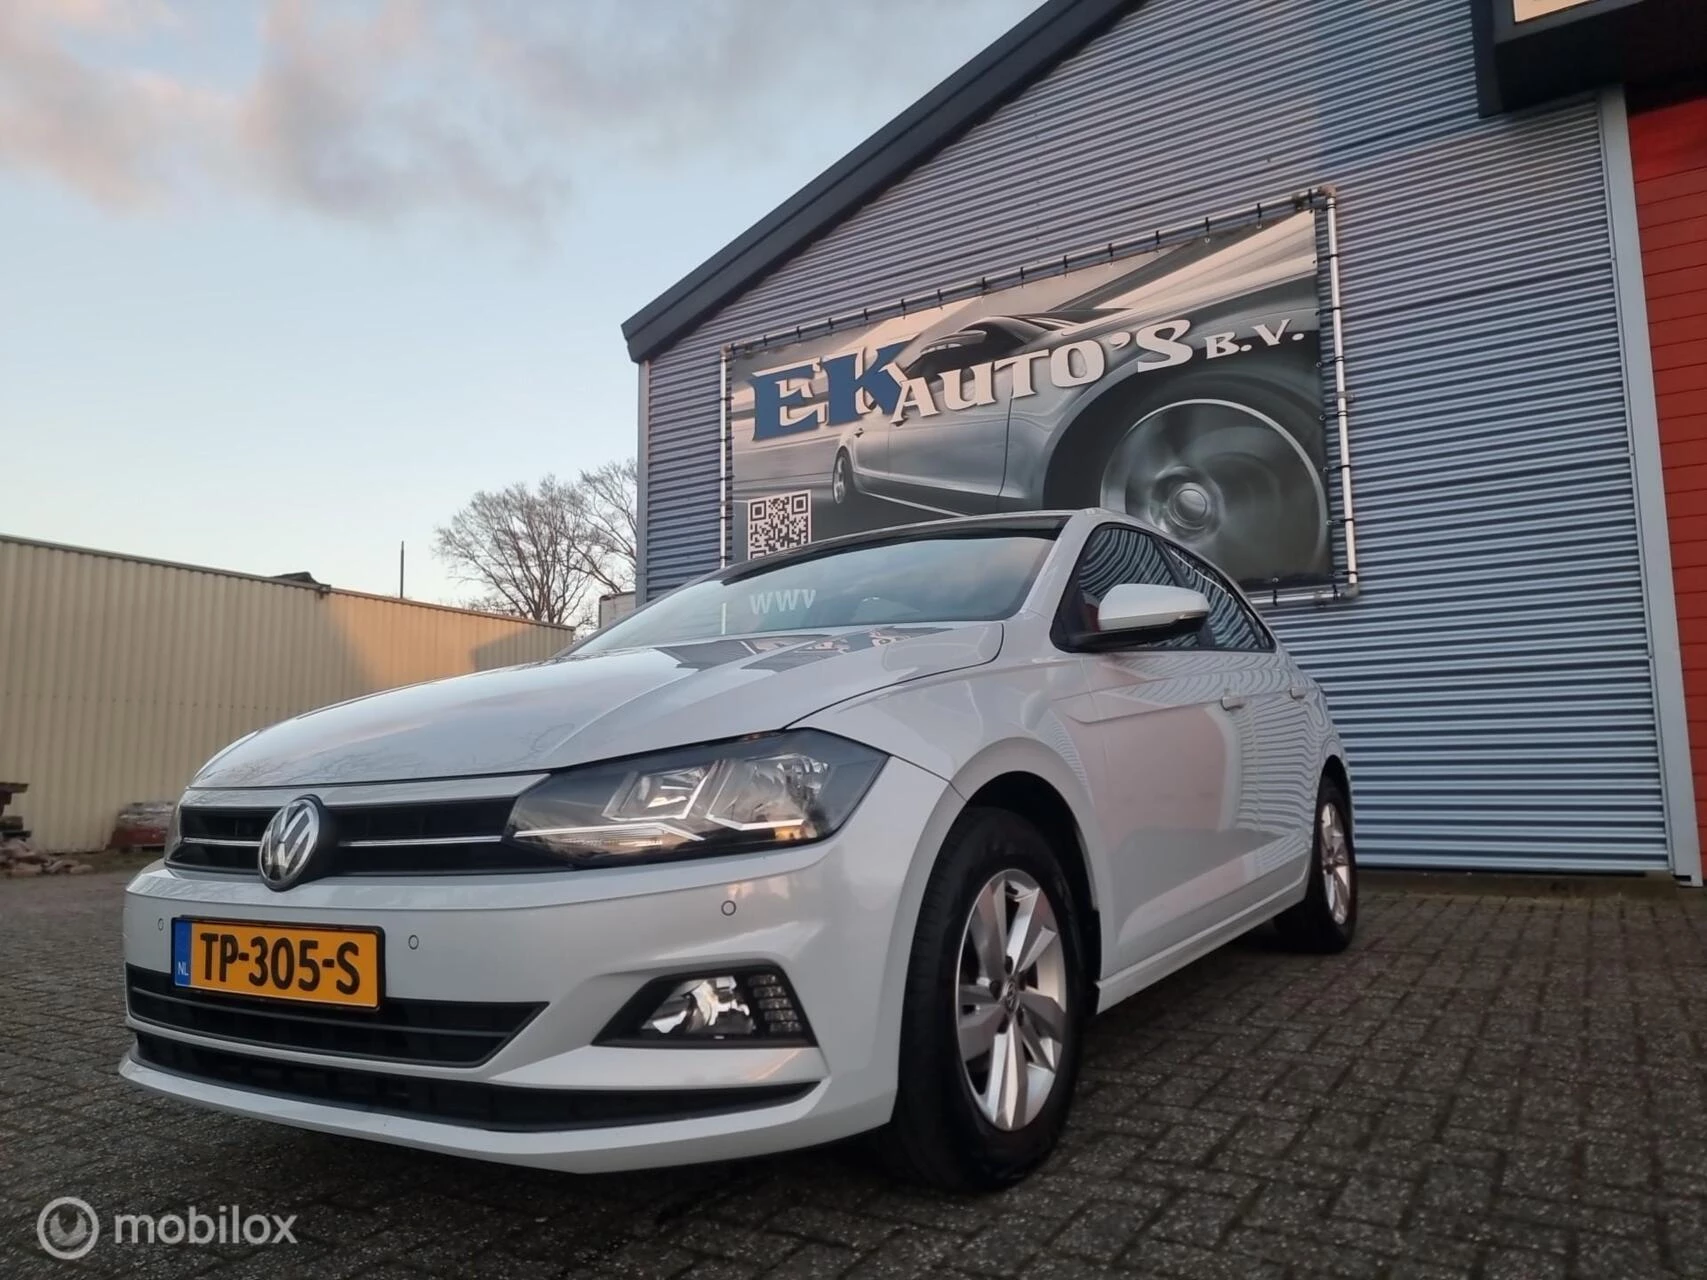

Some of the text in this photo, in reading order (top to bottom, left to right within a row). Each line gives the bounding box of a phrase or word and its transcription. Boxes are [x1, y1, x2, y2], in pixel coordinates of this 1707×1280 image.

[751, 334, 914, 440] EK
[1204, 319, 1304, 360] B.V.
[177, 961, 189, 976] NL
[200, 932, 361, 996] TP-305-S
